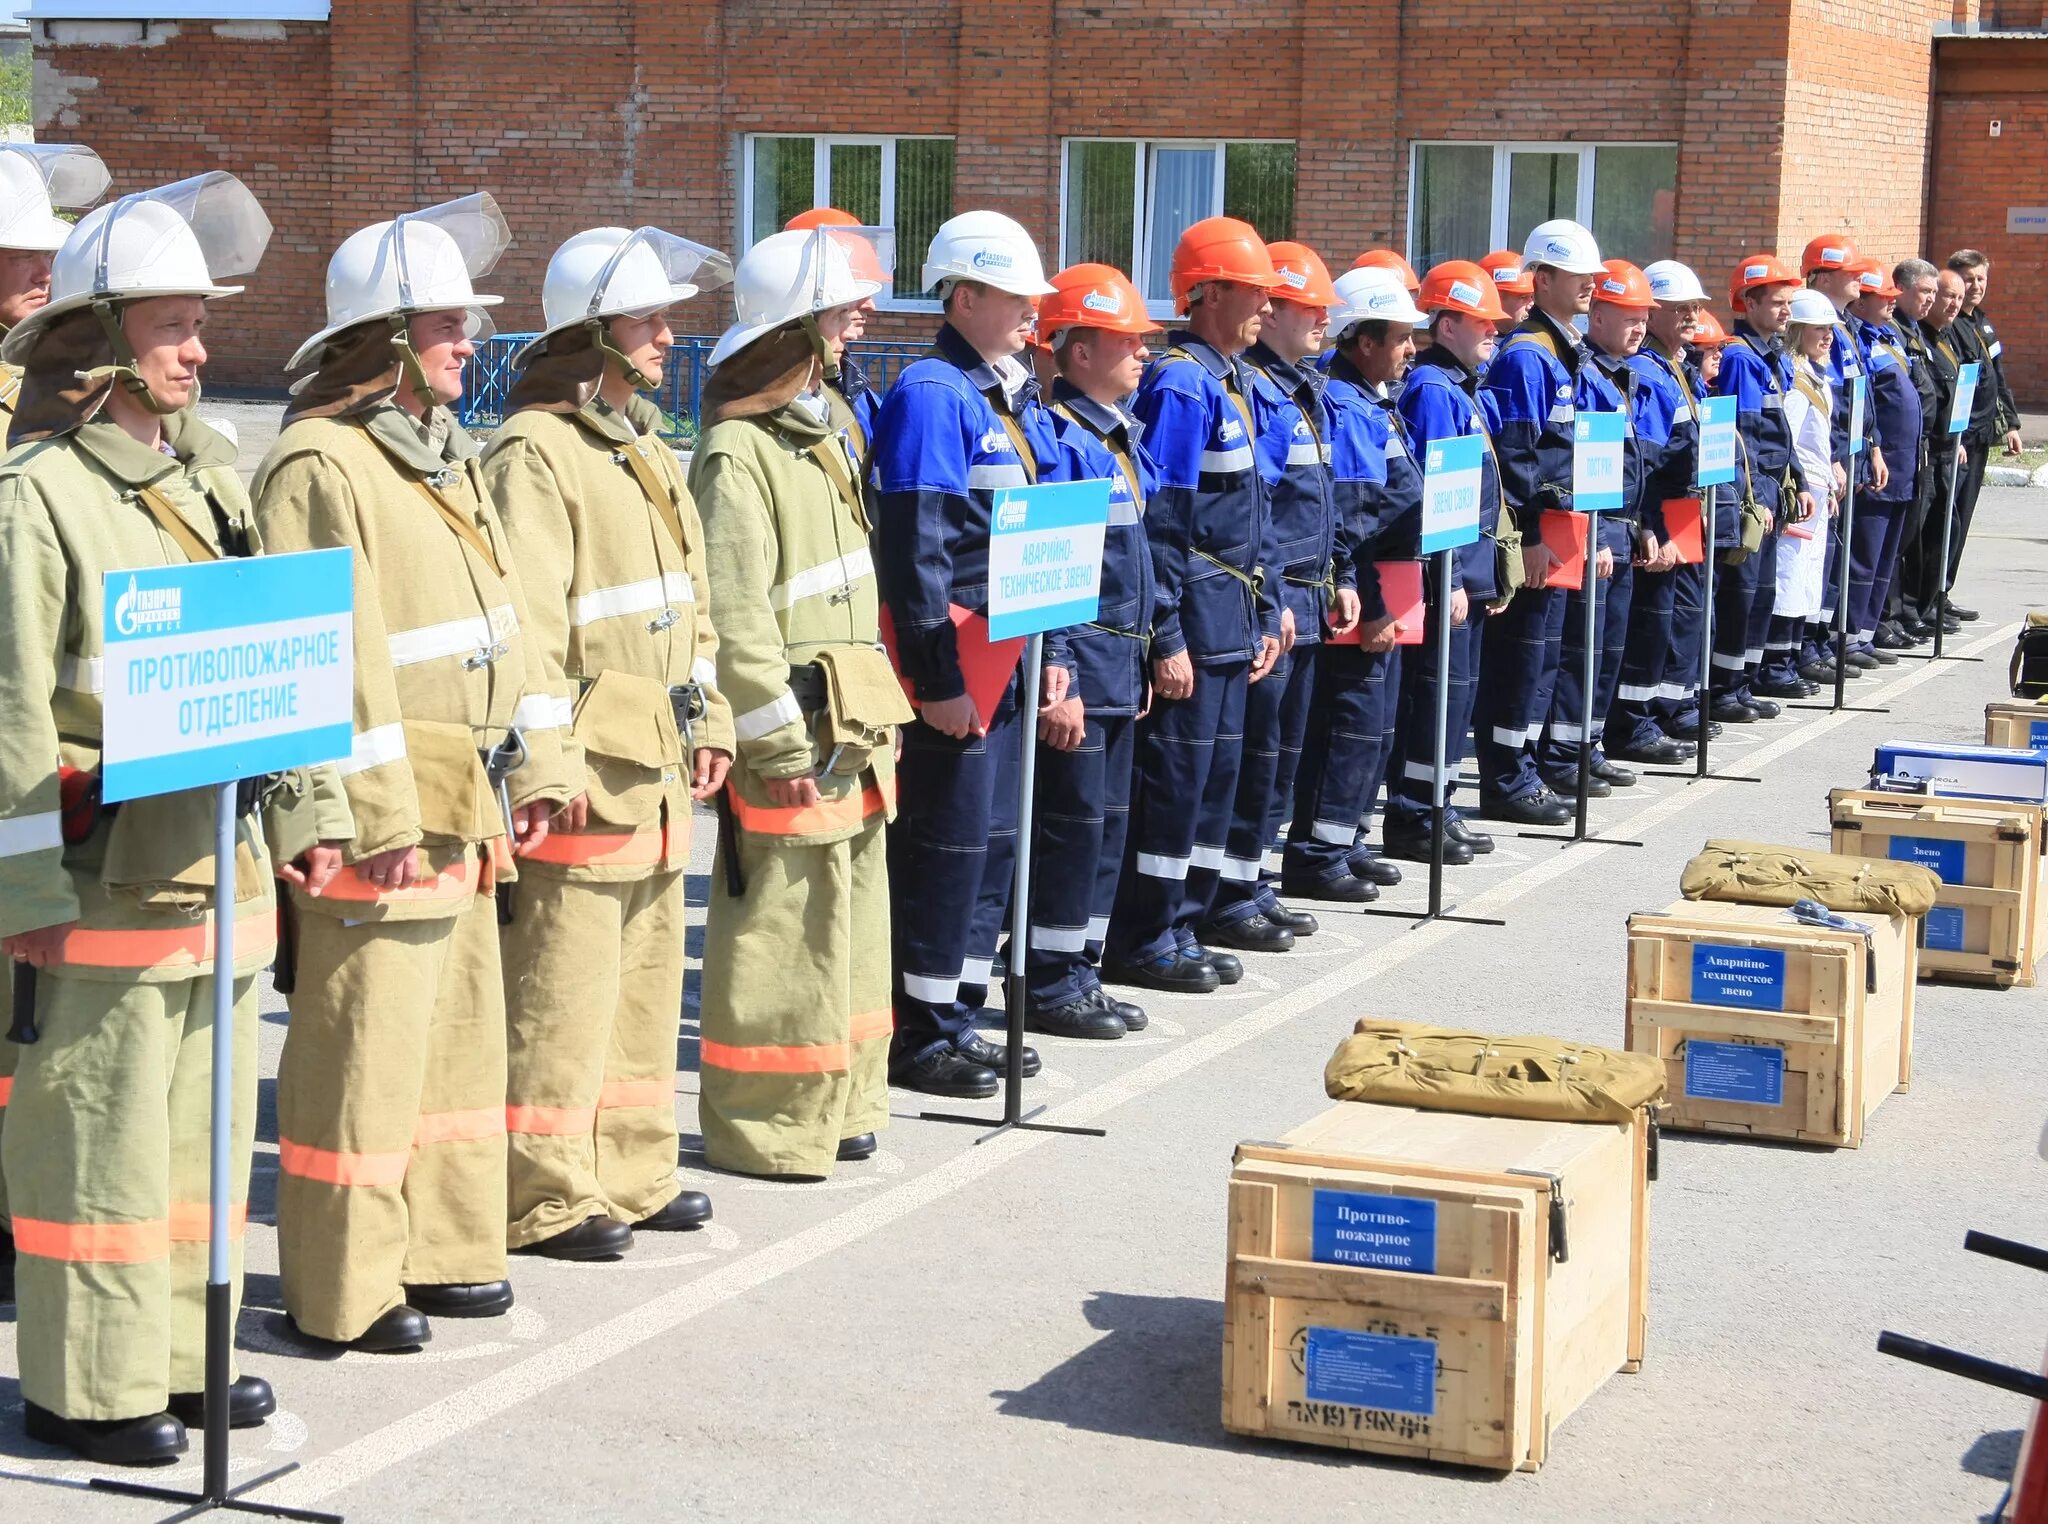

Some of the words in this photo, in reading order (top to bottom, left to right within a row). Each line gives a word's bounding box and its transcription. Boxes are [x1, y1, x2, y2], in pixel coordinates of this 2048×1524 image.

[1022, 536, 1074, 567] АВАРИЙНО-
[1000, 568, 1062, 599] ТЕХНИЧЕСКОЕ
[1064, 564, 1093, 589] ЗВЕНО
[138, 587, 181, 611] ГАЗПРОМ
[138, 621, 181, 633] ТОМСК
[128, 630, 339, 696] ПРОТИВОПОЖАРНОЕ
[178, 682, 298, 737] ОТДЕЛЕНИЕ
[1913, 846, 1941, 857] Звено
[1706, 956, 1770, 969] Аварийно-
[1703, 971, 1774, 985] техническое
[1721, 987, 1753, 997] звено
[1337, 1206, 1411, 1226] Противо-
[1336, 1229, 1411, 1247] пожарное
[1334, 1248, 1412, 1267] отделение
